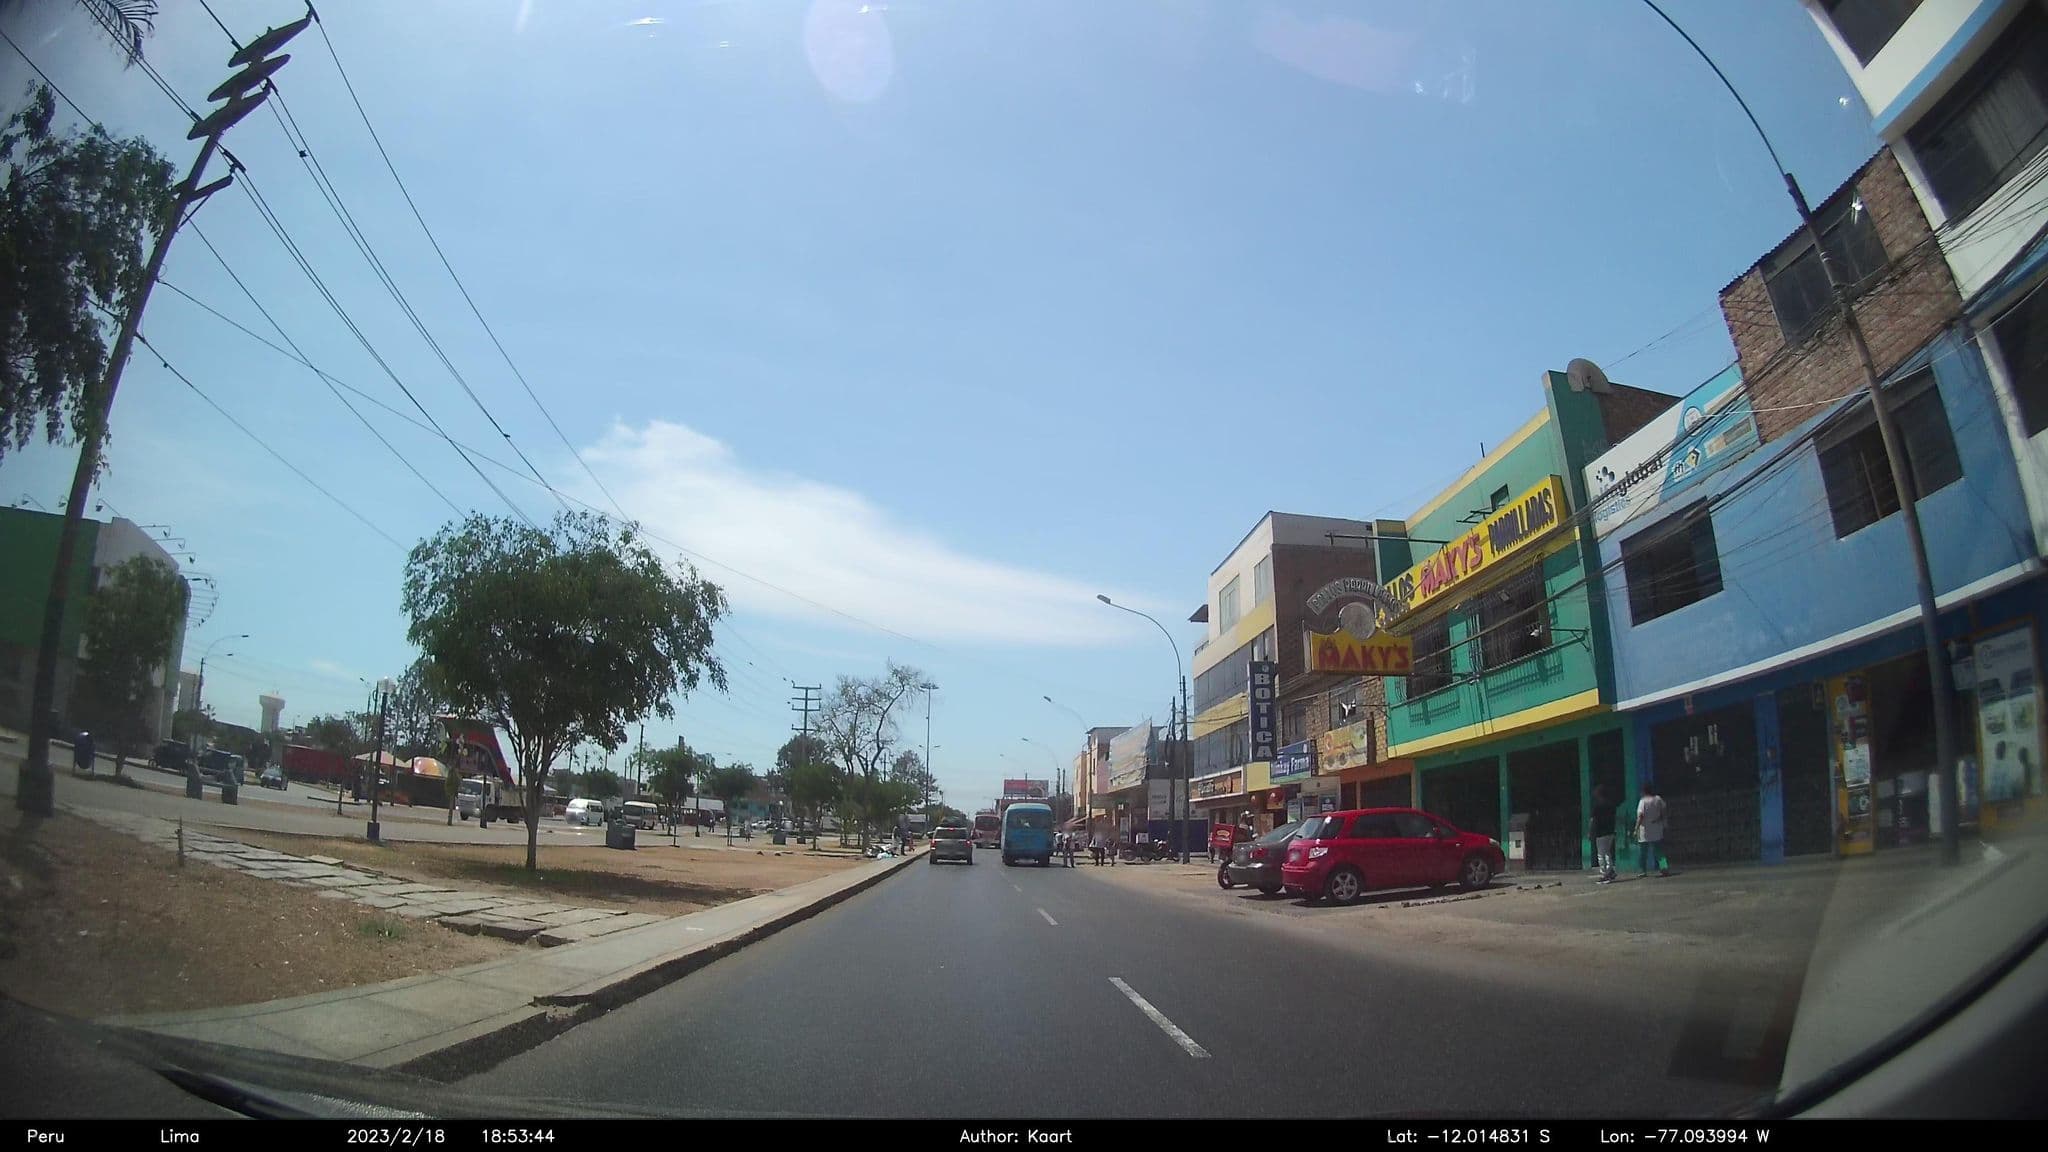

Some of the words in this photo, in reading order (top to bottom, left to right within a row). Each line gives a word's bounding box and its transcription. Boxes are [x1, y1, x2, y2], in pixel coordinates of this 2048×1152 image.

[1419, 532, 1484, 599] MAKY'S
[1487, 487, 1556, 559] PARRILLADAS
[1318, 638, 1410, 670] MAKY'S
[1254, 673, 1273, 758] BOTICA
